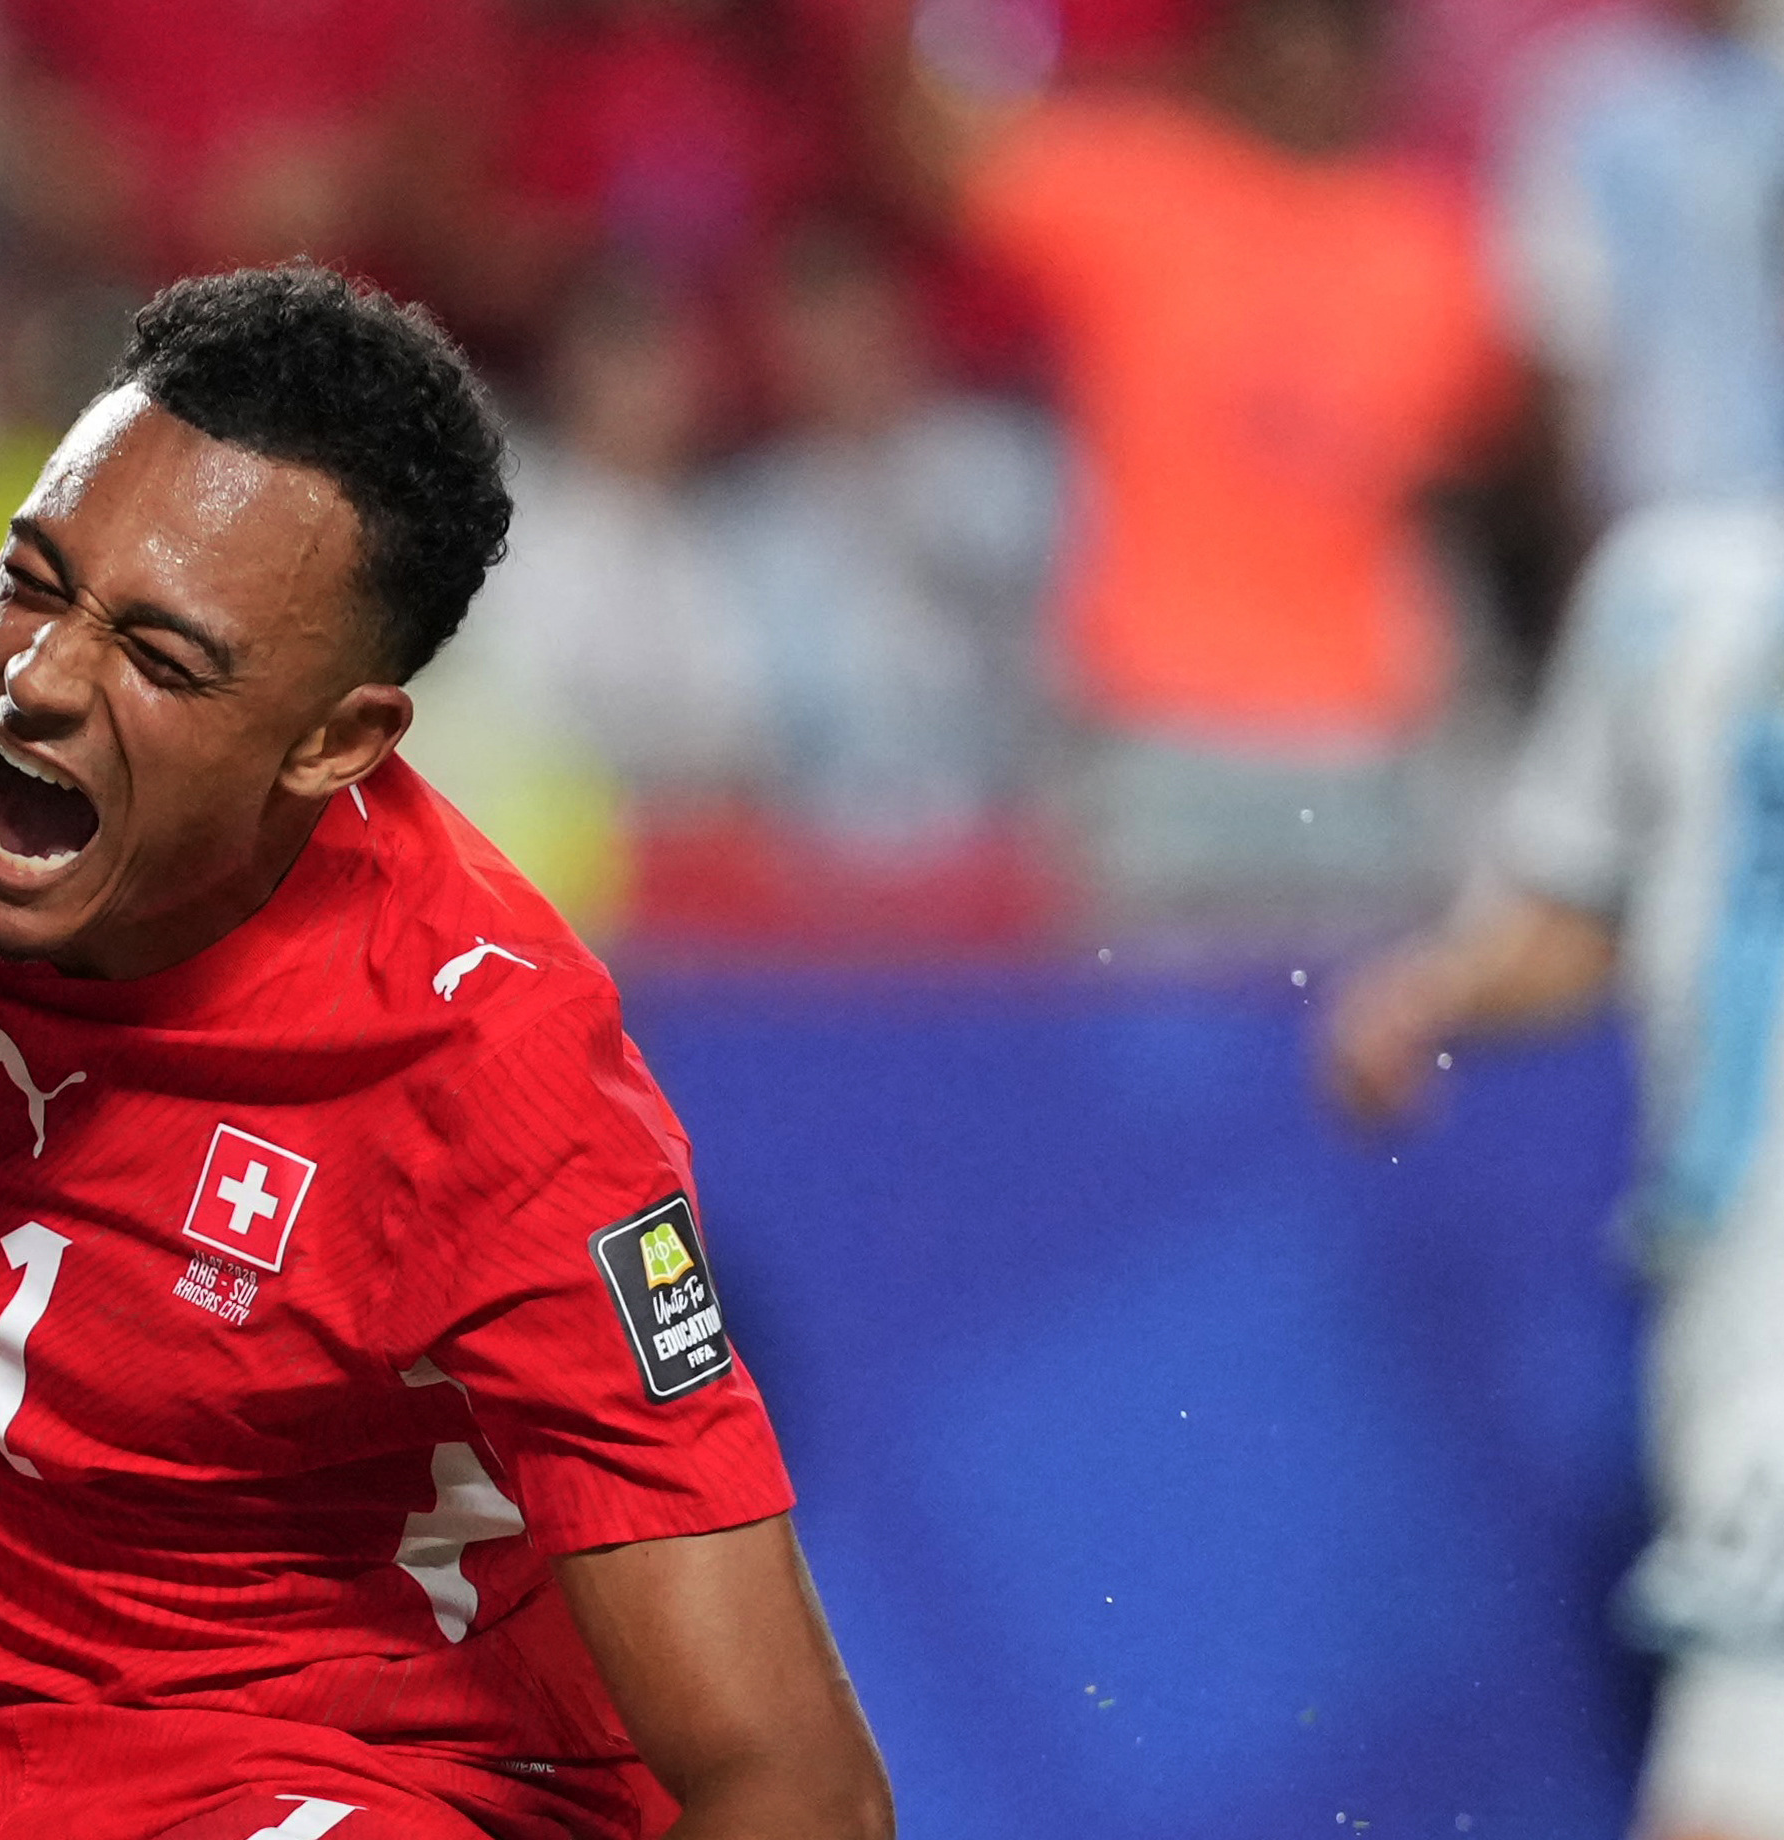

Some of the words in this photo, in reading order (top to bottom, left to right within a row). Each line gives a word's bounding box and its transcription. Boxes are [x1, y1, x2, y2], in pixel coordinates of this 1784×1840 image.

[172, 1277, 223, 1313] KANSAS
[219, 1300, 251, 1326] CITY
[228, 1277, 259, 1308] SUI
[652, 1287, 688, 1324] Unite
[652, 1304, 721, 1360] EDUCATION
[687, 1344, 717, 1368] FIFA
